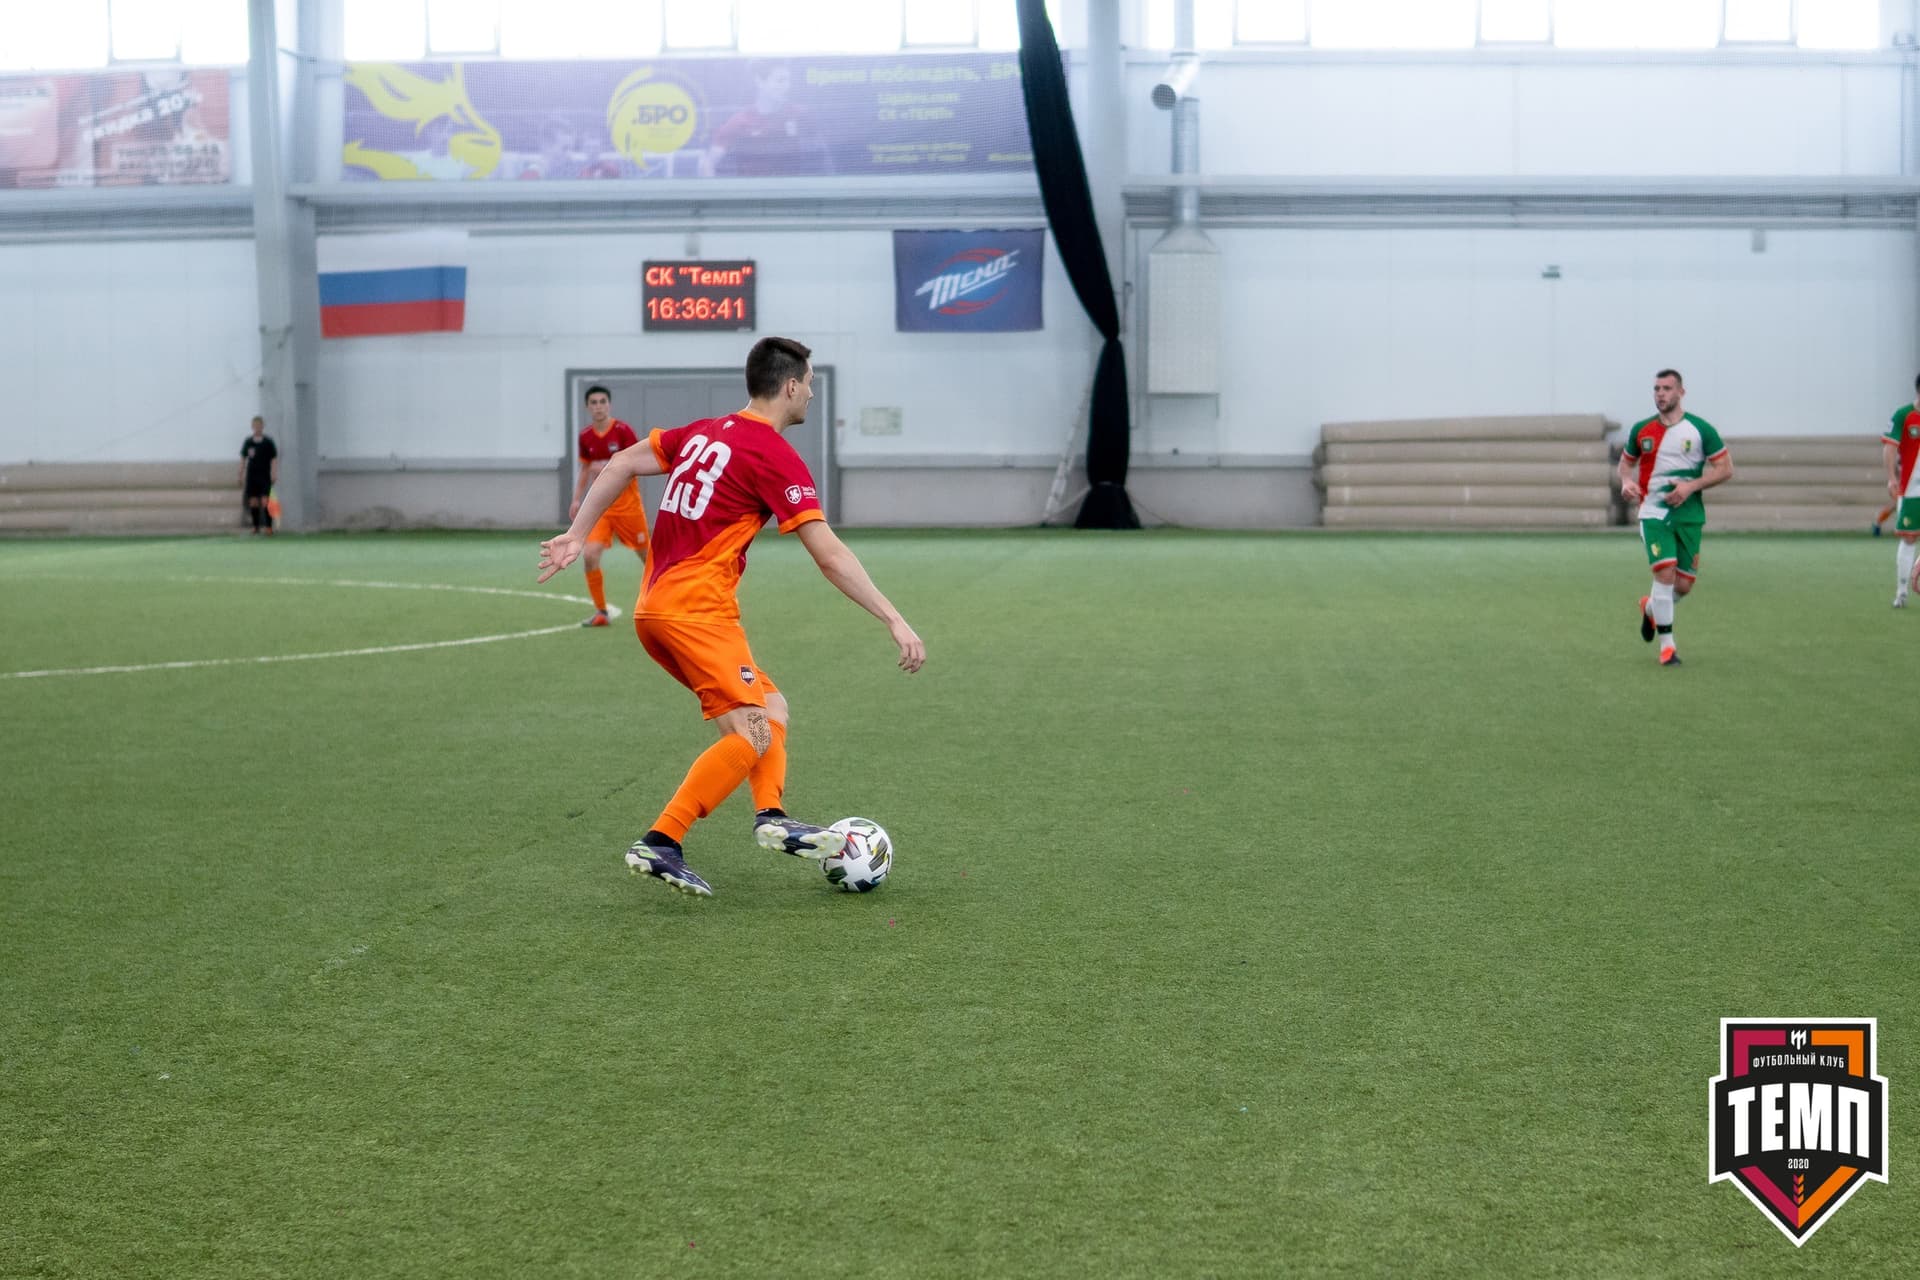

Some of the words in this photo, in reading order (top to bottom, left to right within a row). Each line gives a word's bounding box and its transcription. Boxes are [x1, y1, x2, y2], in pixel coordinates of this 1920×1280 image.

[646, 266, 676, 287] СК
[678, 266, 753, 287] "Темп"
[647, 296, 746, 321] 16:36:41
[659, 434, 732, 521] 23
